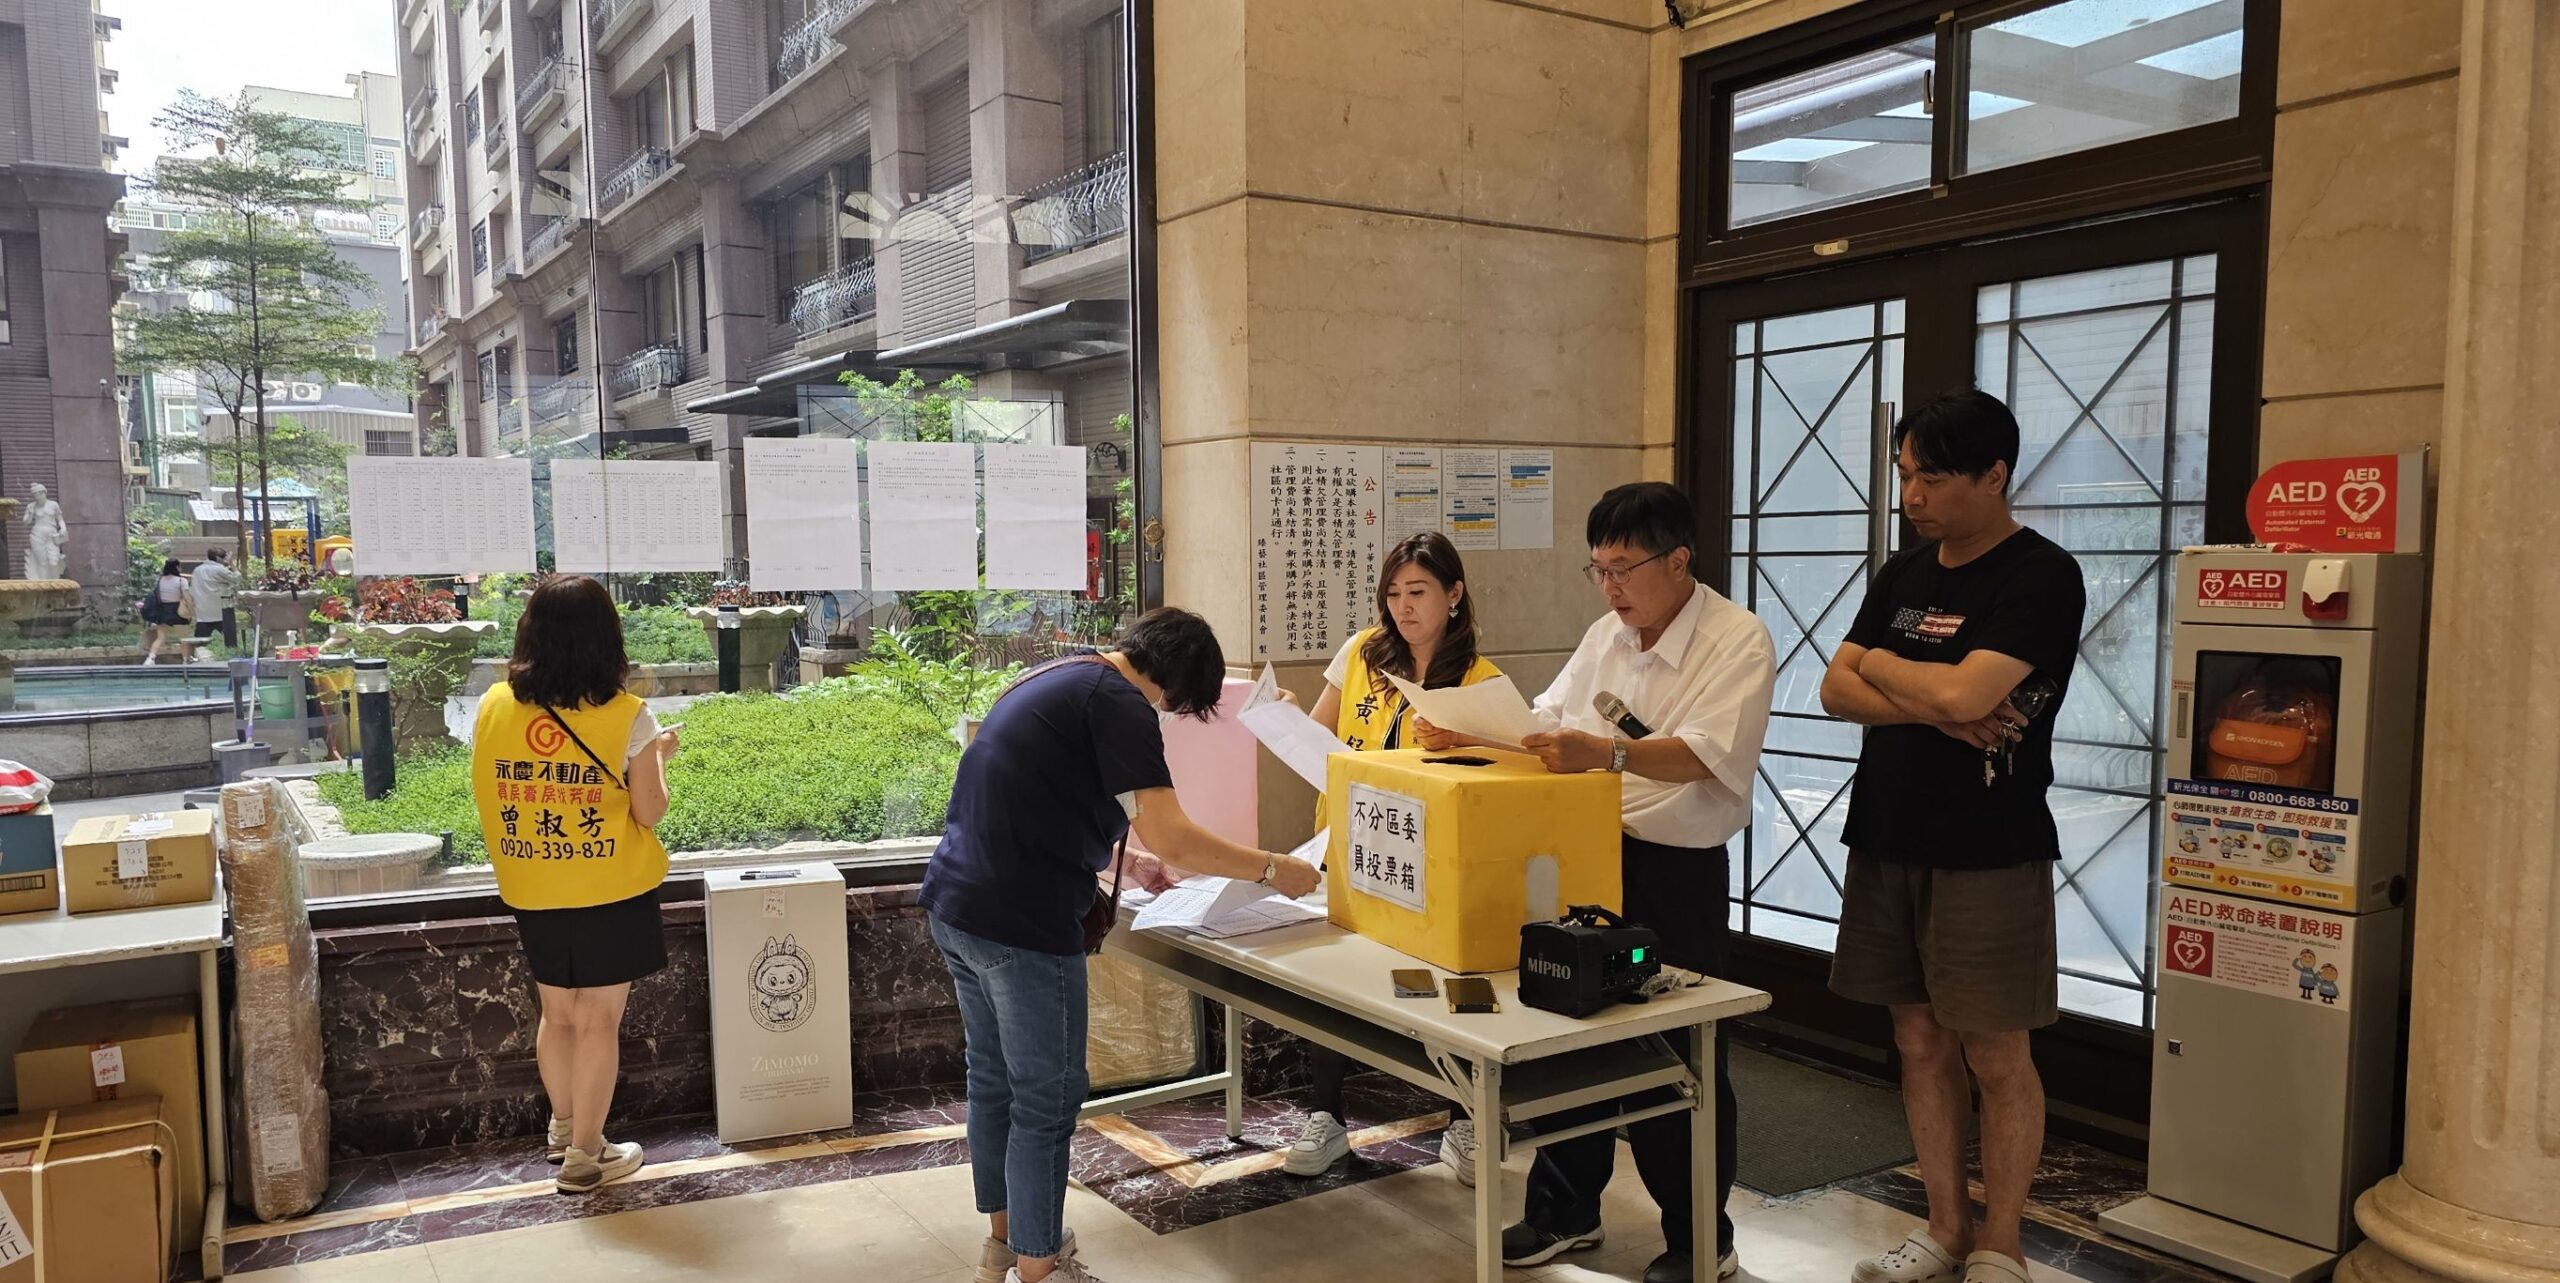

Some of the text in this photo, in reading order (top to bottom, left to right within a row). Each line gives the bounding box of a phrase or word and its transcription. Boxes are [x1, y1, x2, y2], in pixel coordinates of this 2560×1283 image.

[2343, 467, 2381, 482] AED
[1363, 476, 1377, 526] 公告
[2266, 481, 2328, 504] AED
[2206, 572, 2223, 580] AED
[2228, 572, 2283, 589] AED
[495, 759, 605, 784] 永慶不動產
[2224, 764, 2278, 785] AED
[2249, 790, 2350, 813] 0800-668-850
[500, 804, 605, 838] 曾淑芳
[1354, 801, 1417, 843] 不分區委
[500, 838, 616, 860] 0920-339-827
[1354, 844, 1415, 893] 員投票箱
[2177, 930, 2203, 943] AED
